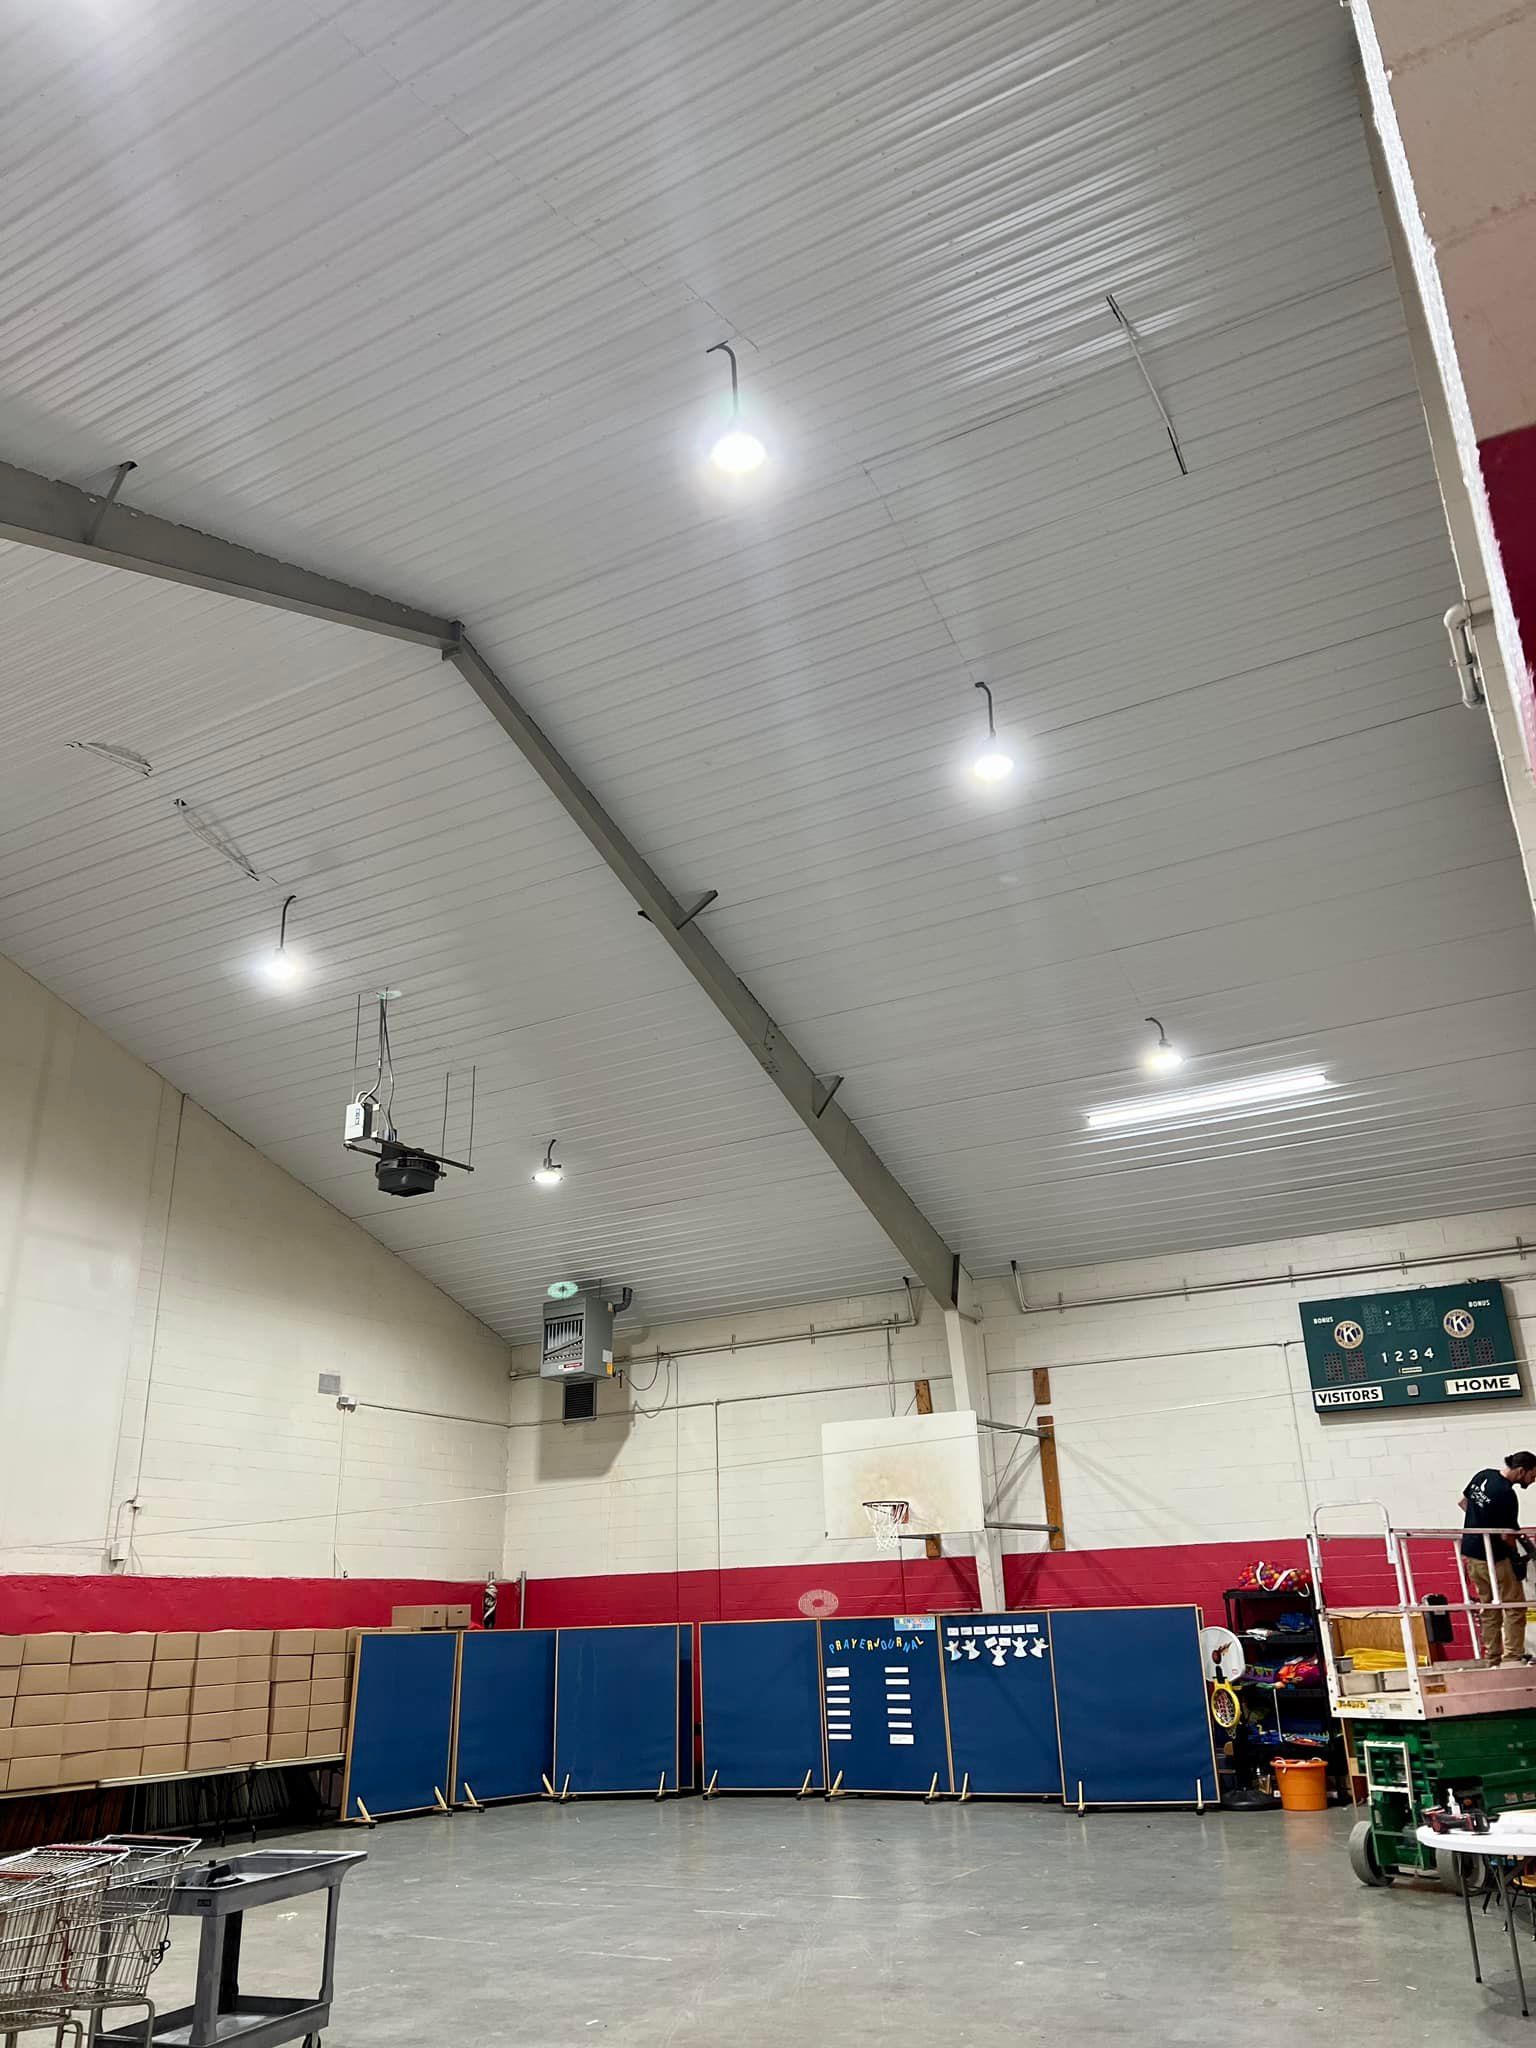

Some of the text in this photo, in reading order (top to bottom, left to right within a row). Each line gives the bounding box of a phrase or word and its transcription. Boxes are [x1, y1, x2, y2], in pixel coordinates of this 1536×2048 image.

[1468, 1299, 1491, 1308] BONUS
[1313, 1316, 1334, 1325] BONUS
[1455, 1377, 1512, 1392] HOME
[1317, 1388, 1380, 1404] VISITORS
